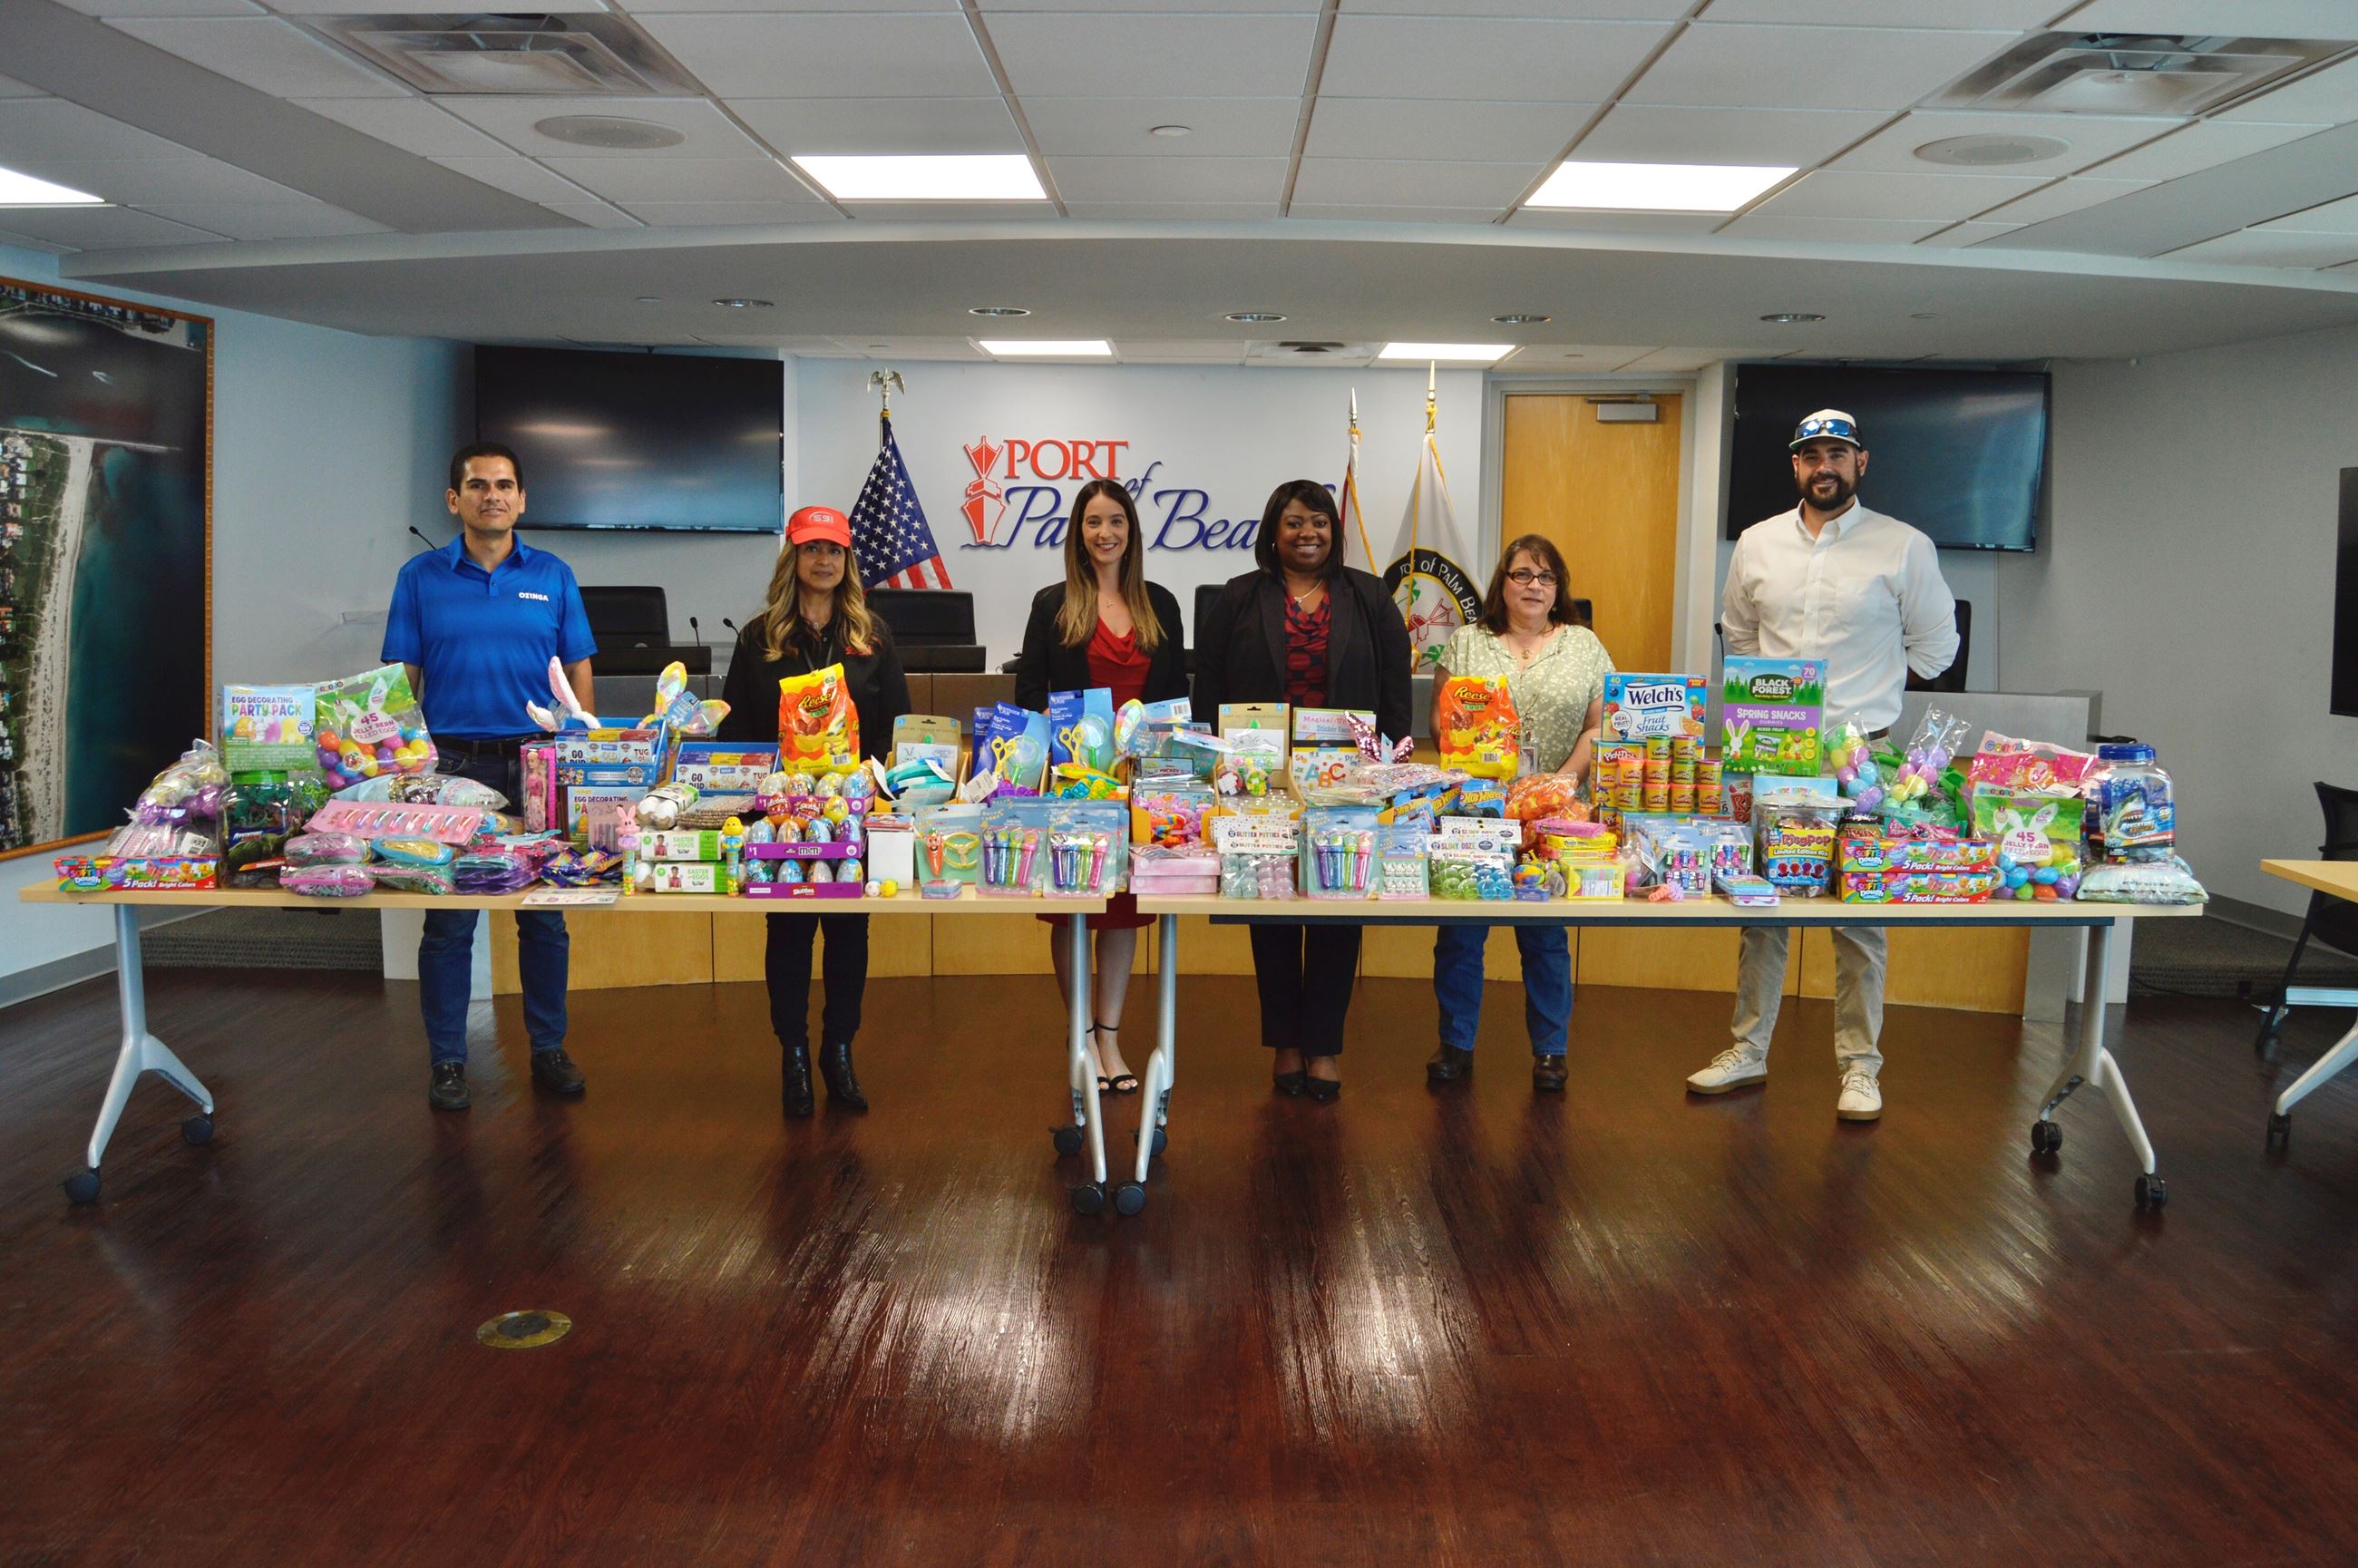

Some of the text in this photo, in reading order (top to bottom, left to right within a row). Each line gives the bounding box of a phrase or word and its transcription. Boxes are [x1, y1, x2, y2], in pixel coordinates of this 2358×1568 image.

[1004, 439, 1128, 480] PORT
[1125, 461, 1163, 502] of
[1004, 486, 1262, 552] Pa Bea
[518, 591, 550, 602] OZINGA
[1803, 667, 1816, 676] 70
[1755, 678, 1789, 687] BLACK
[1453, 686, 1492, 700] Reese
[1627, 687, 1683, 706] Welch's
[1752, 687, 1792, 695] FOREST
[798, 689, 833, 708] Reese
[231, 704, 302, 716] PARTY PACK
[1736, 707, 1807, 721] SPRING SNACKS
[360, 712, 379, 725] 45
[1642, 715, 1666, 726] Fruit
[1635, 723, 1671, 734] Snacks
[571, 750, 584, 759] GO
[691, 773, 703, 783] GO
[2016, 831, 2035, 842] 45
[1855, 850, 1886, 859] SOFTEE
[1857, 857, 1884, 865] Dough
[1902, 860, 1911, 870] 5
[1910, 862, 1934, 871] Pack!
[122, 878, 132, 888] 5
[132, 879, 157, 888] Pack!
[1856, 882, 1888, 891] SOFTEE
[1859, 890, 1885, 898] Dough
[1902, 892, 1912, 902] 5
[1911, 893, 1934, 902] Pack!
